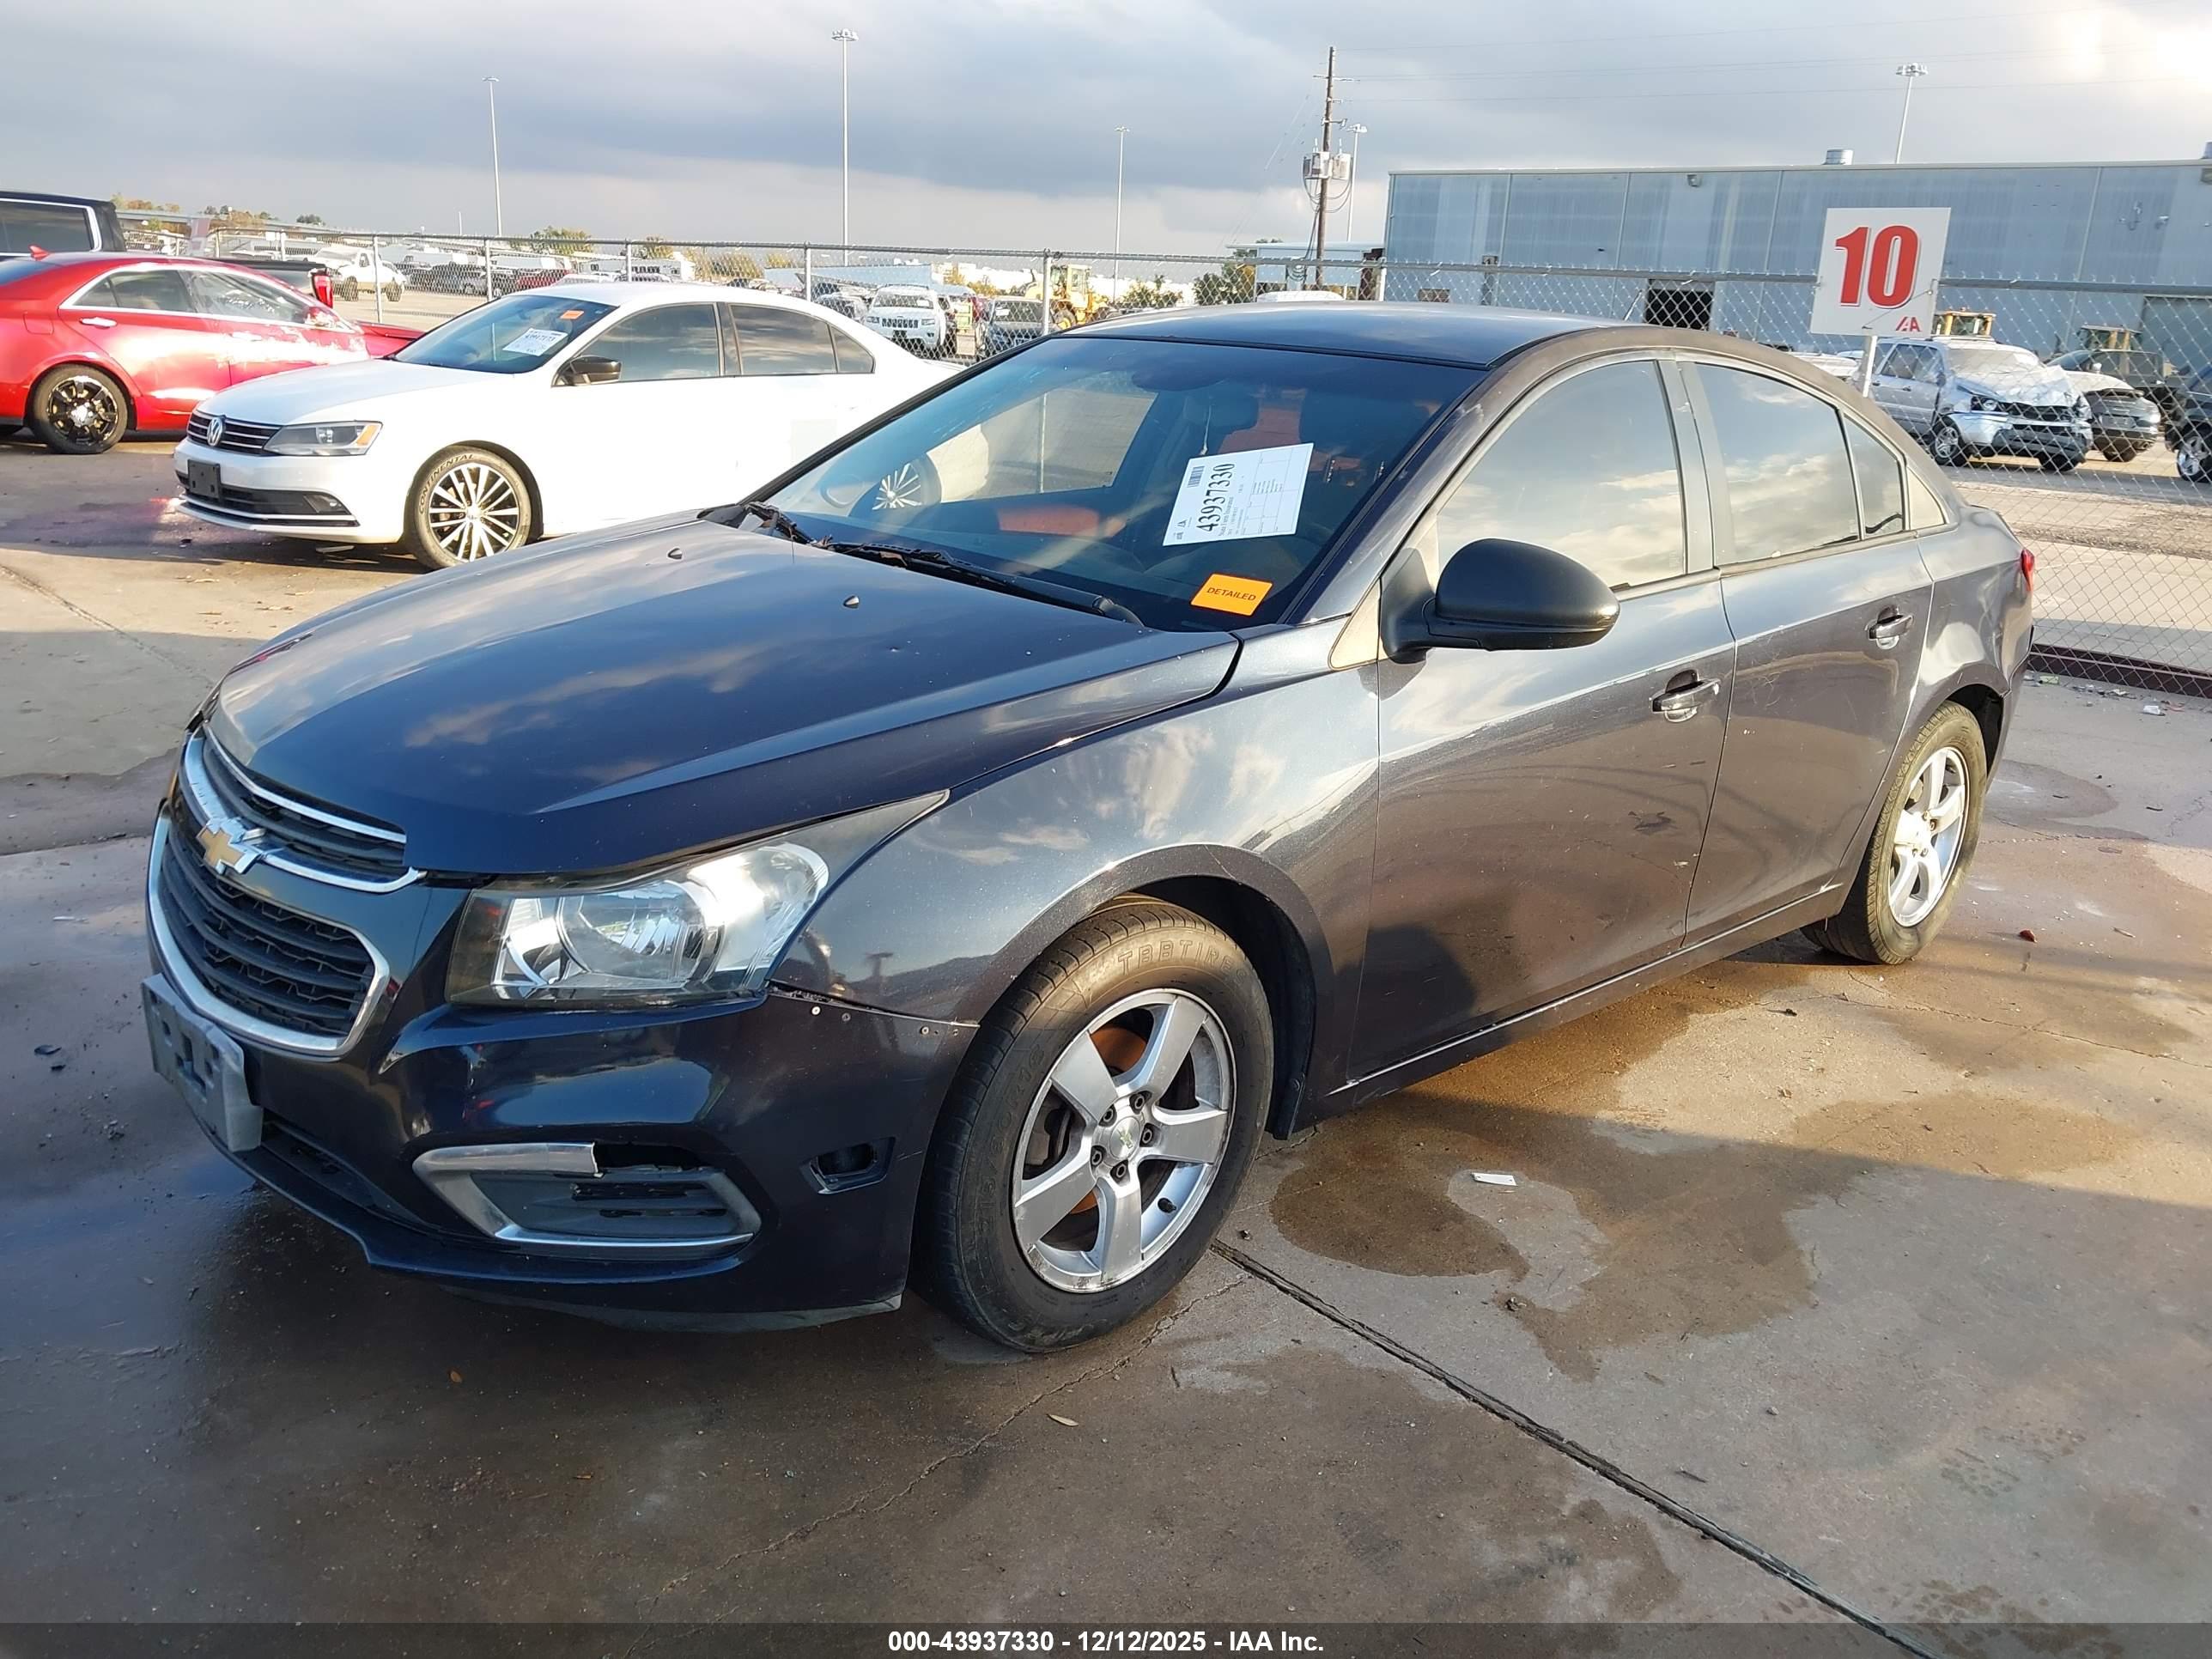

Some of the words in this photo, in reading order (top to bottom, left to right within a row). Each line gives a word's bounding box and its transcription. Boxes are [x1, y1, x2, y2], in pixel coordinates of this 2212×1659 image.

[1834, 224, 1921, 309] 10
[418, 453, 474, 515] CONTINENTAL
[1195, 464, 1235, 532] 43937330
[1206, 586, 1256, 601] DETAILED
[1118, 939, 1249, 988] TBBTIRES
